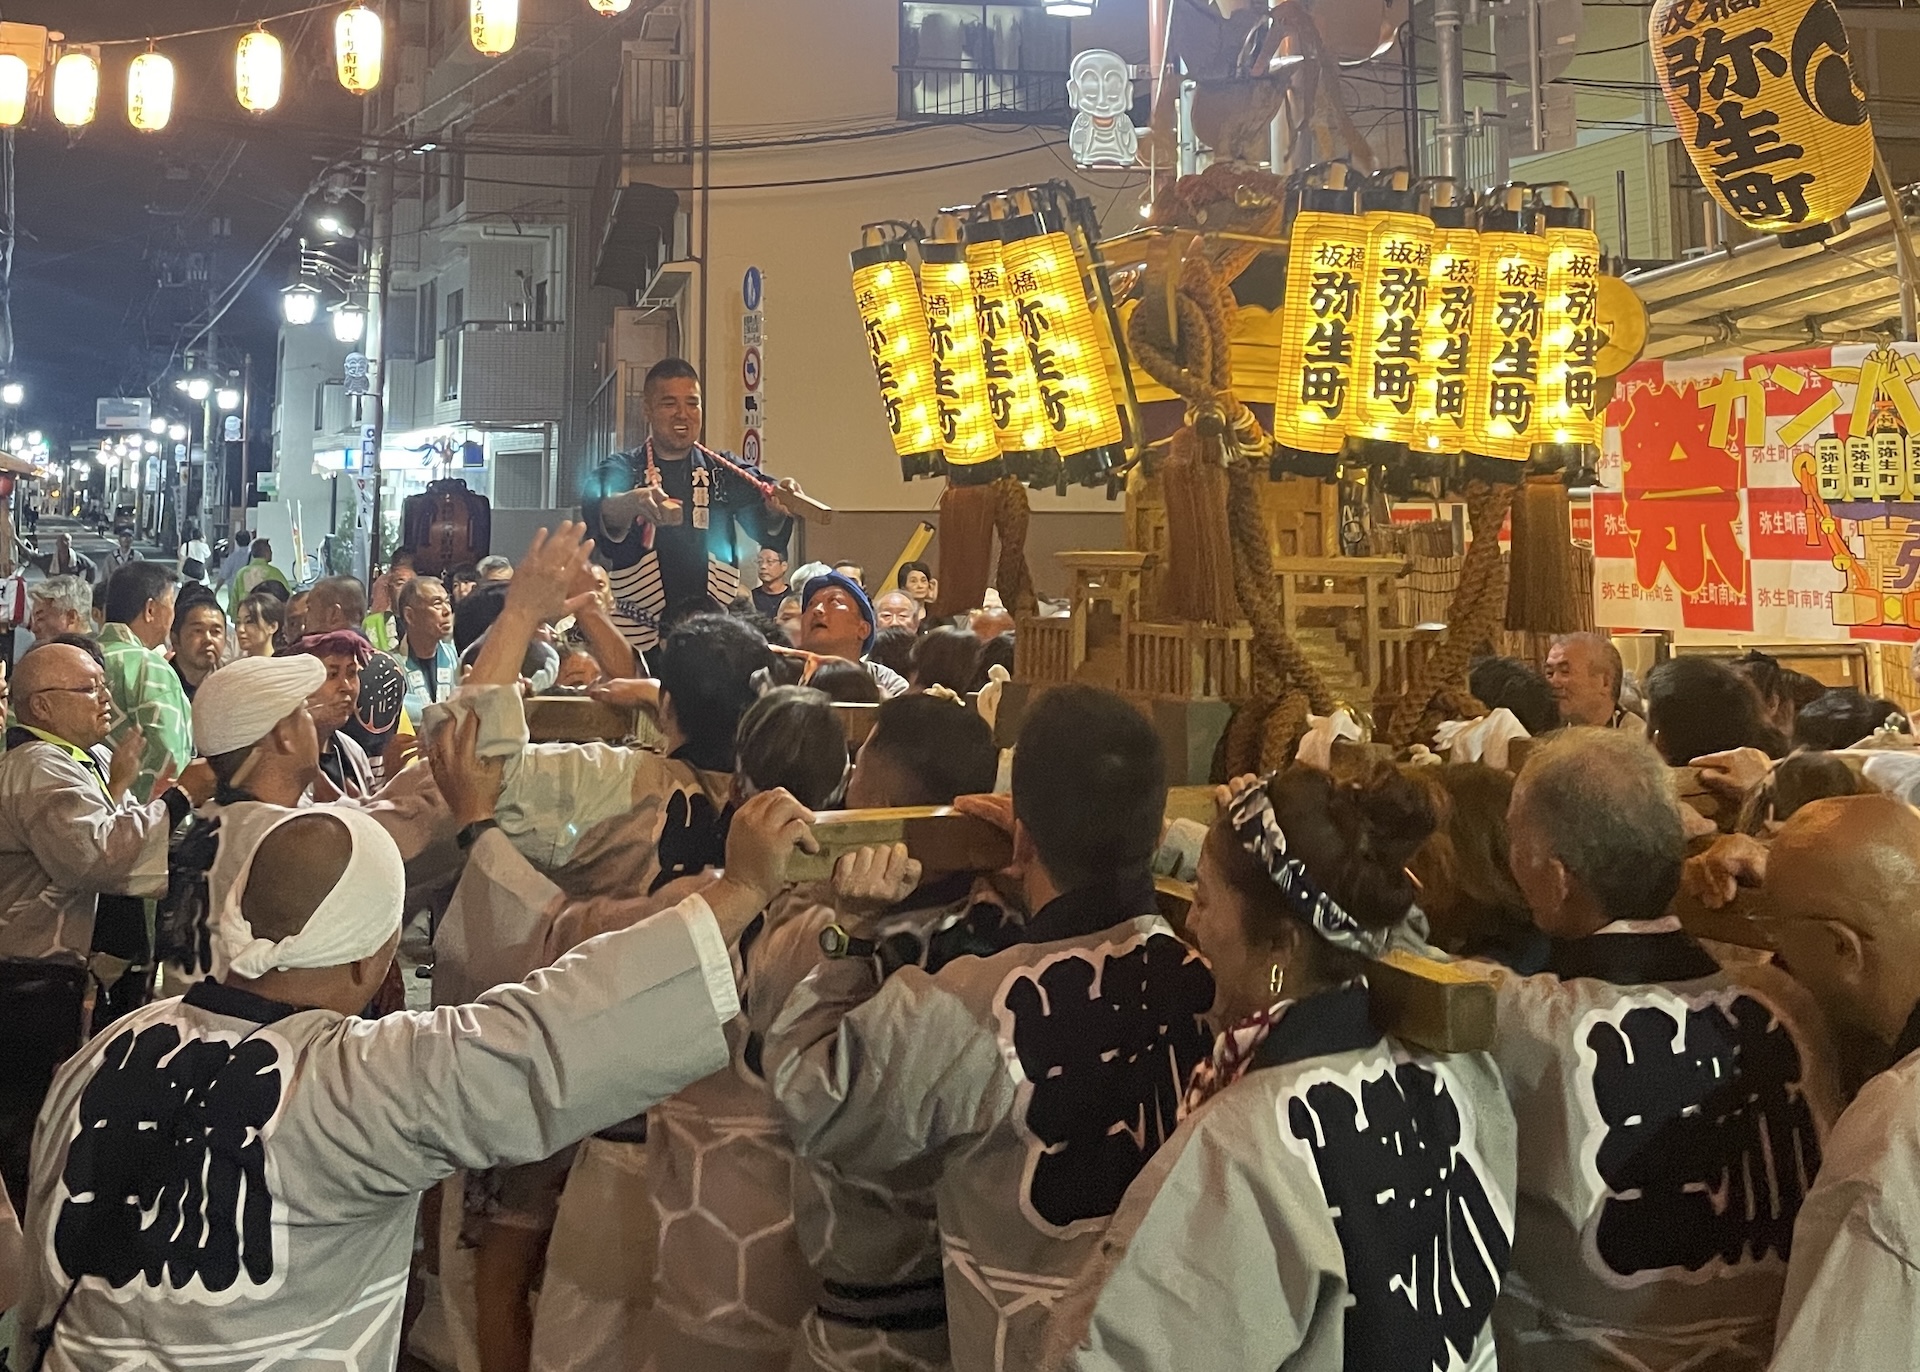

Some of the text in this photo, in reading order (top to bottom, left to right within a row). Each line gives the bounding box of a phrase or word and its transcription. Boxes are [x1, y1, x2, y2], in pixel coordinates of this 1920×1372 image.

[1663, 27, 1815, 223] 弥生町
[1567, 256, 1599, 279] 板
[1302, 271, 1361, 420] 弥生町
[1374, 268, 1428, 415] 弥生町
[1490, 291, 1544, 434] 弥生町
[746, 441, 756, 460] 30
[1621, 381, 1746, 596] 祭
[1820, 452, 1840, 490] 弥生町
[1851, 450, 1870, 488] 弥生町
[1878, 447, 1898, 486] 弥生町
